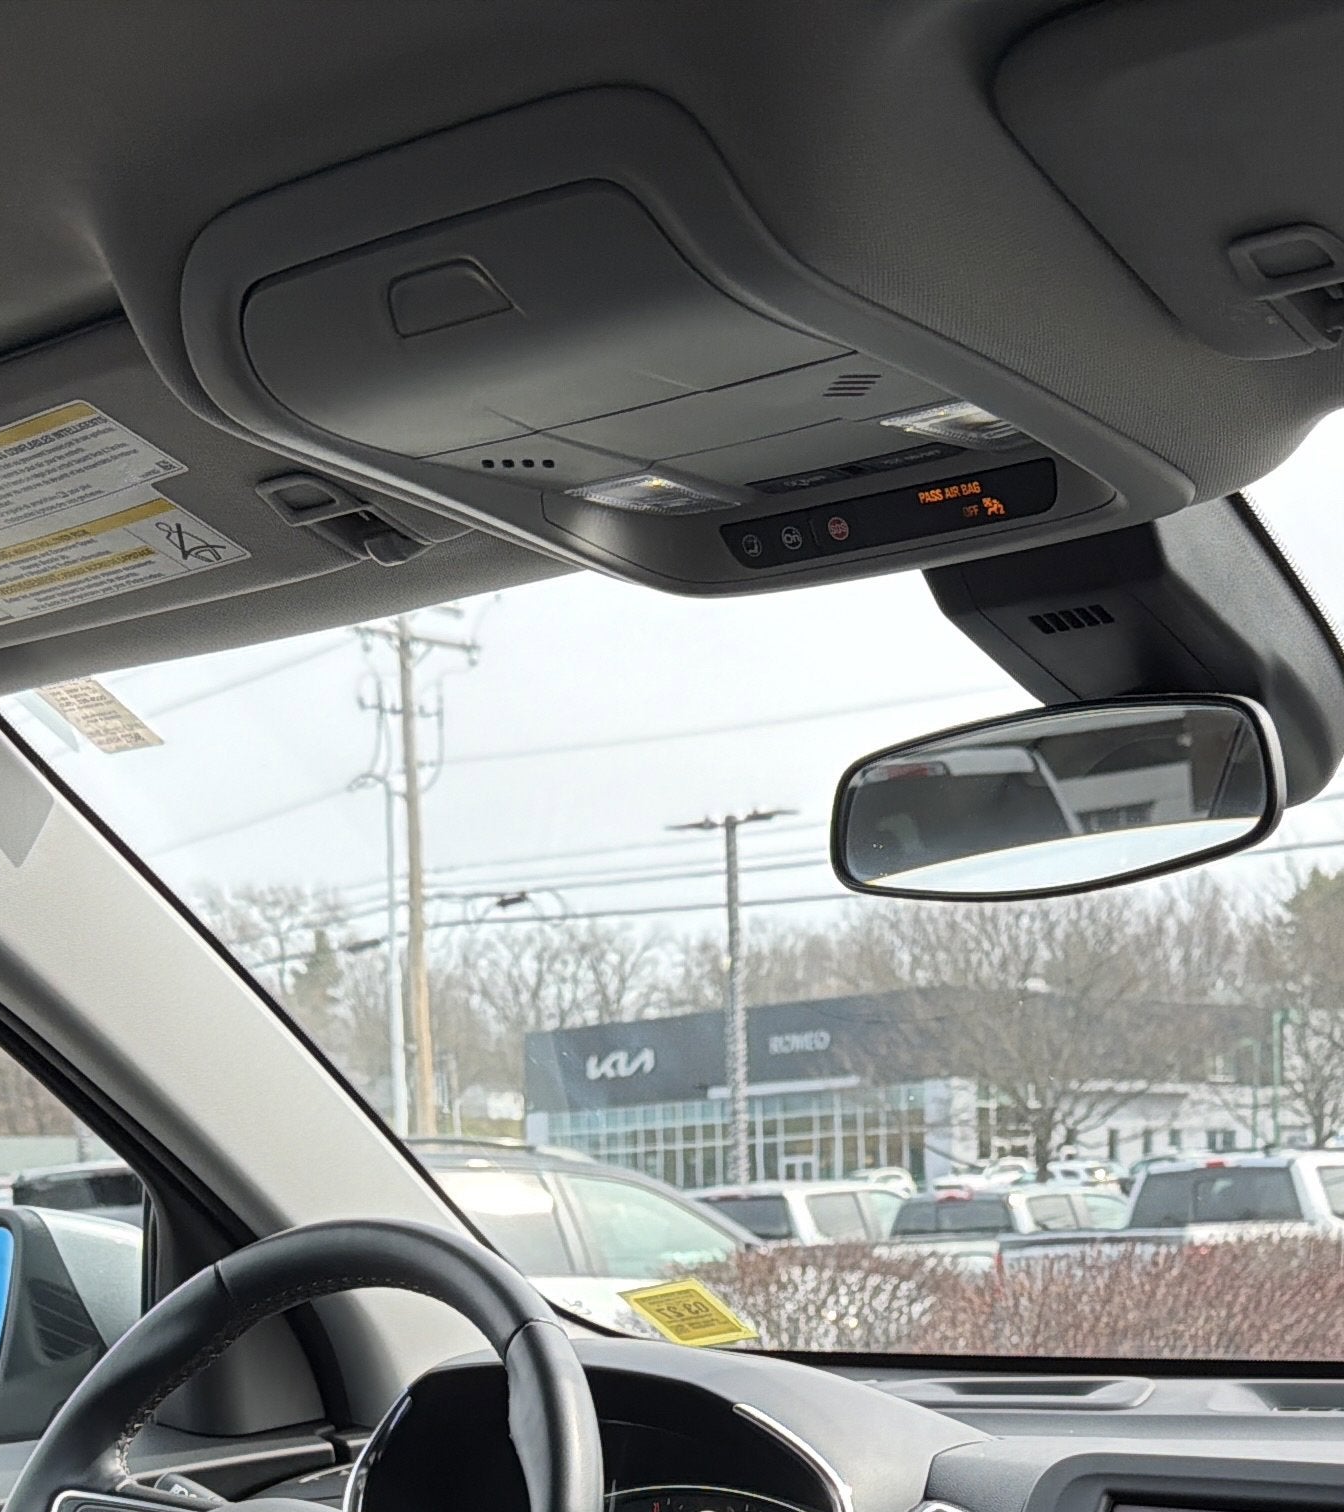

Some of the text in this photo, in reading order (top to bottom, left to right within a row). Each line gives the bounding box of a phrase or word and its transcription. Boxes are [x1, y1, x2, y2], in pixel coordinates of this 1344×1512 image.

[918, 481, 982, 504] PASS AIR BAG
[963, 505, 979, 518] OFF
[830, 522, 848, 535] SOS
